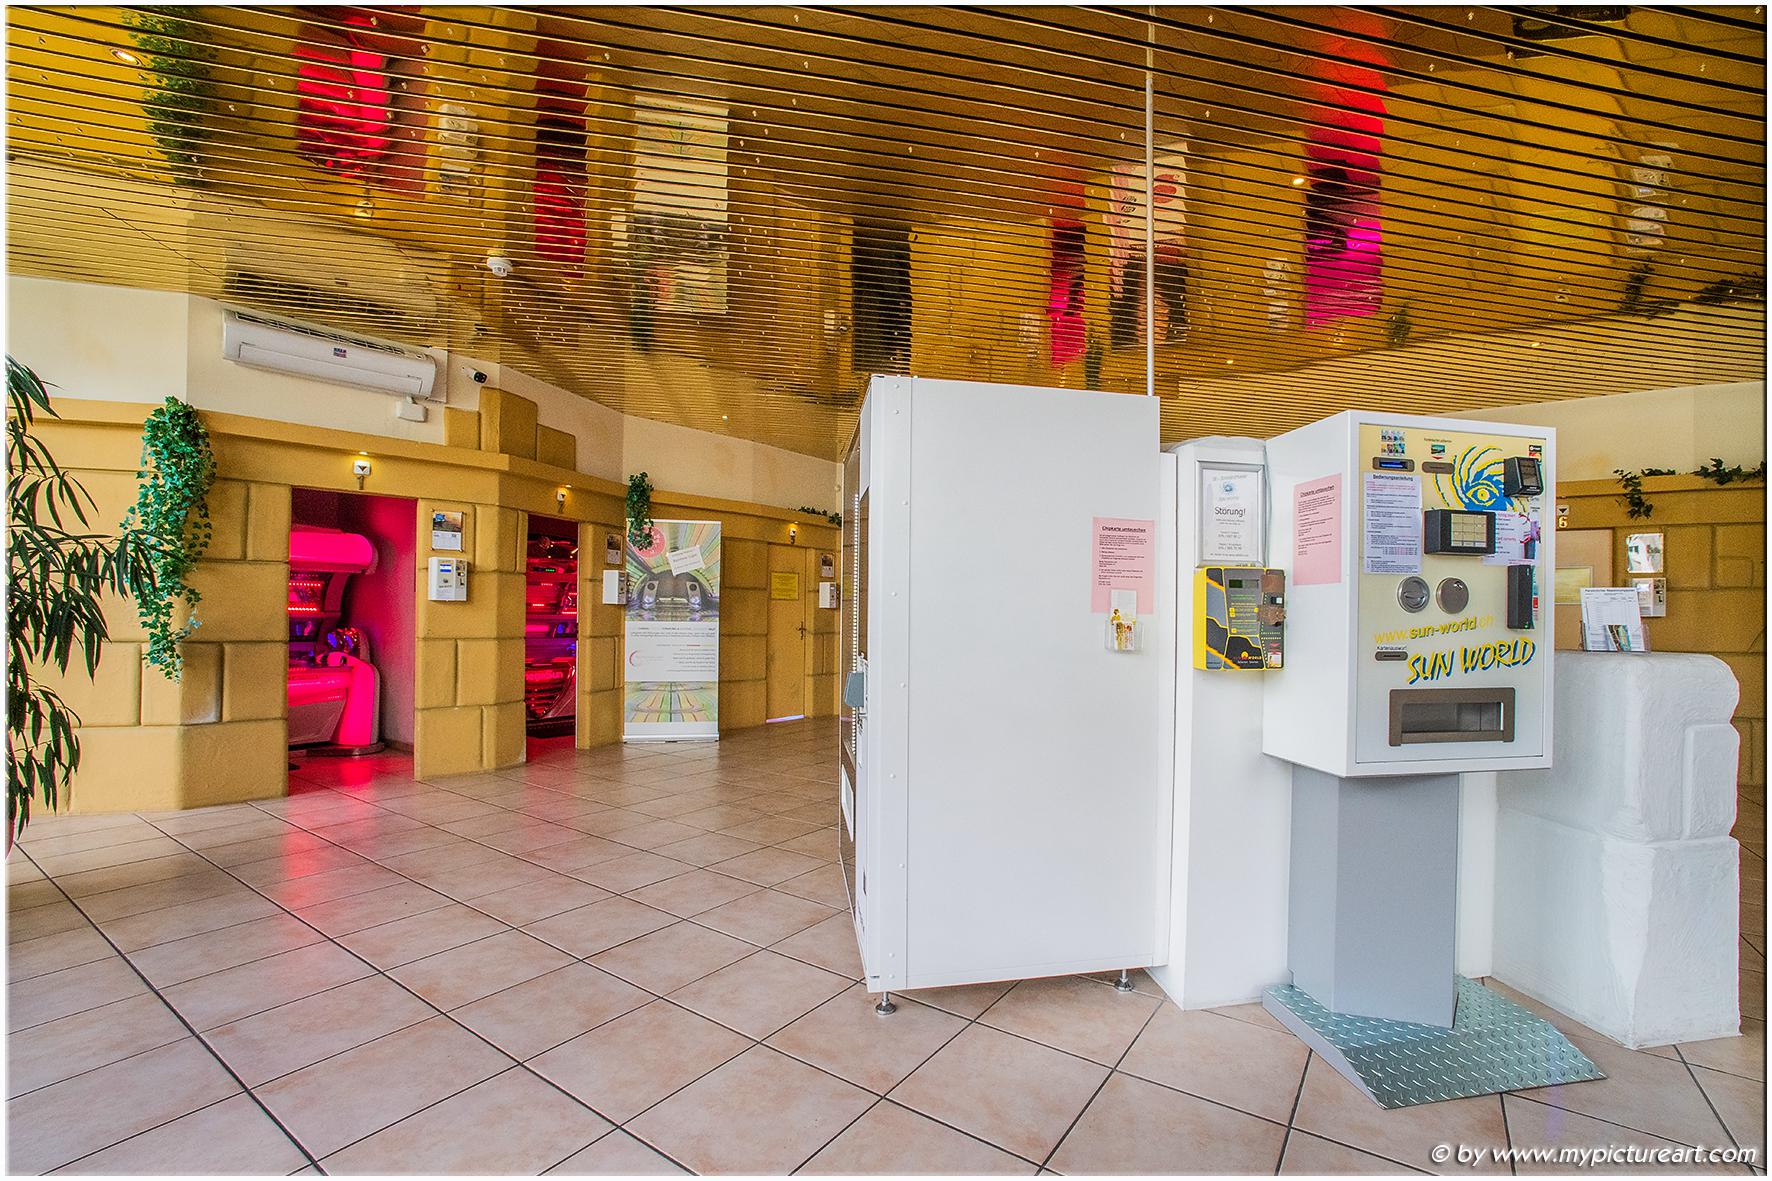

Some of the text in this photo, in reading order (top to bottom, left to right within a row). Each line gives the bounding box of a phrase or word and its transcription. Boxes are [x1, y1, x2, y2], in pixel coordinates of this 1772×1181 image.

[1214, 506, 1246, 518] Störung!
[1558, 515, 1568, 528] 6
[1374, 615, 1495, 644] www.sun-world.ch
[1406, 636, 1537, 685] SUN WORLD
[525, 669, 564, 681] egaSun
